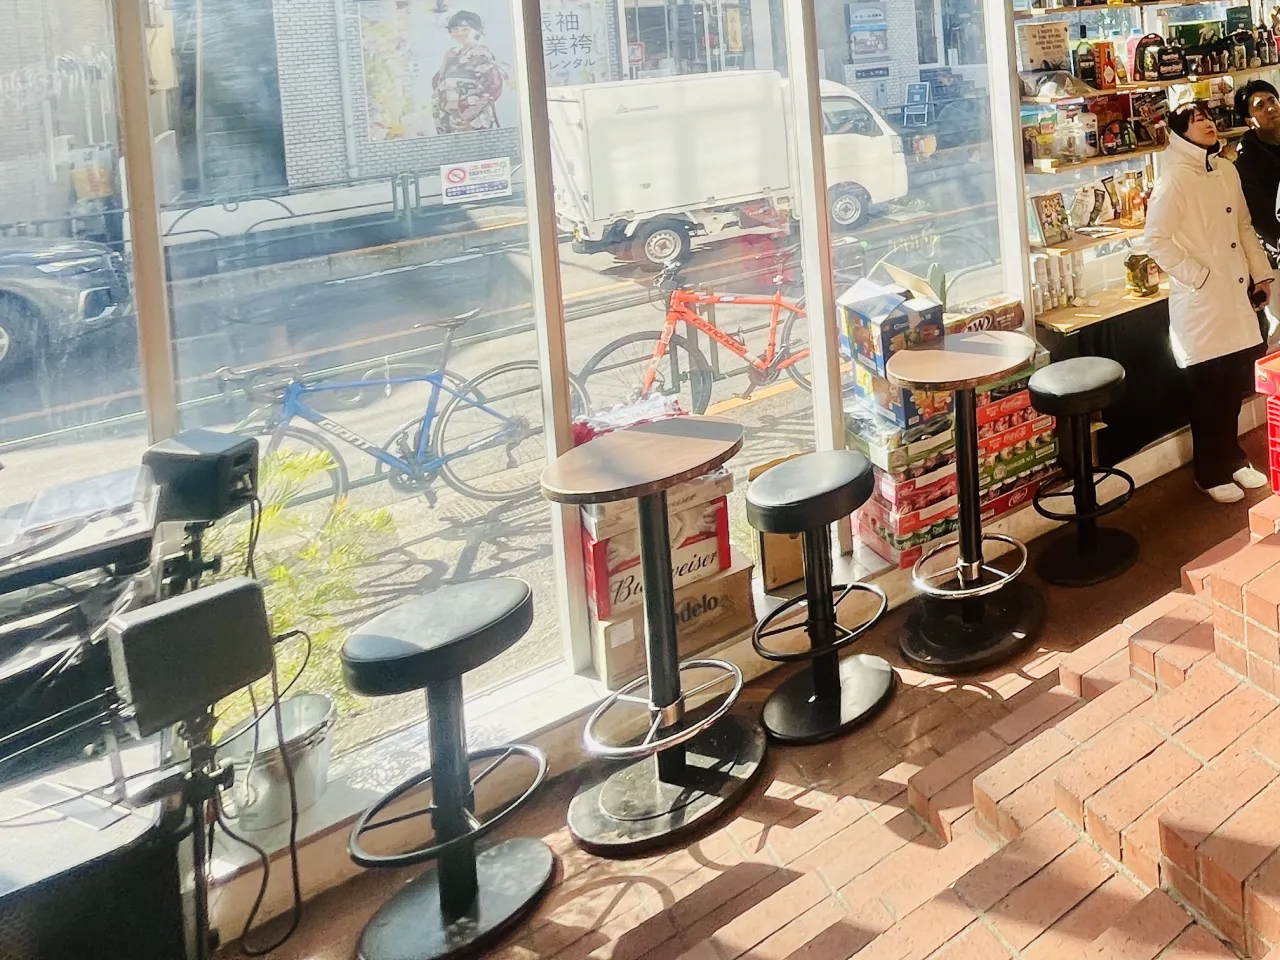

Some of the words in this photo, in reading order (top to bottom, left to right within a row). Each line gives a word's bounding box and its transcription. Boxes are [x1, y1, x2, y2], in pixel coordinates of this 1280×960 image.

[543, 34, 593, 56] 業袴
[549, 57, 596, 70] レンタル
[609, 550, 719, 606] Bueiser
[675, 594, 719, 625] delo
